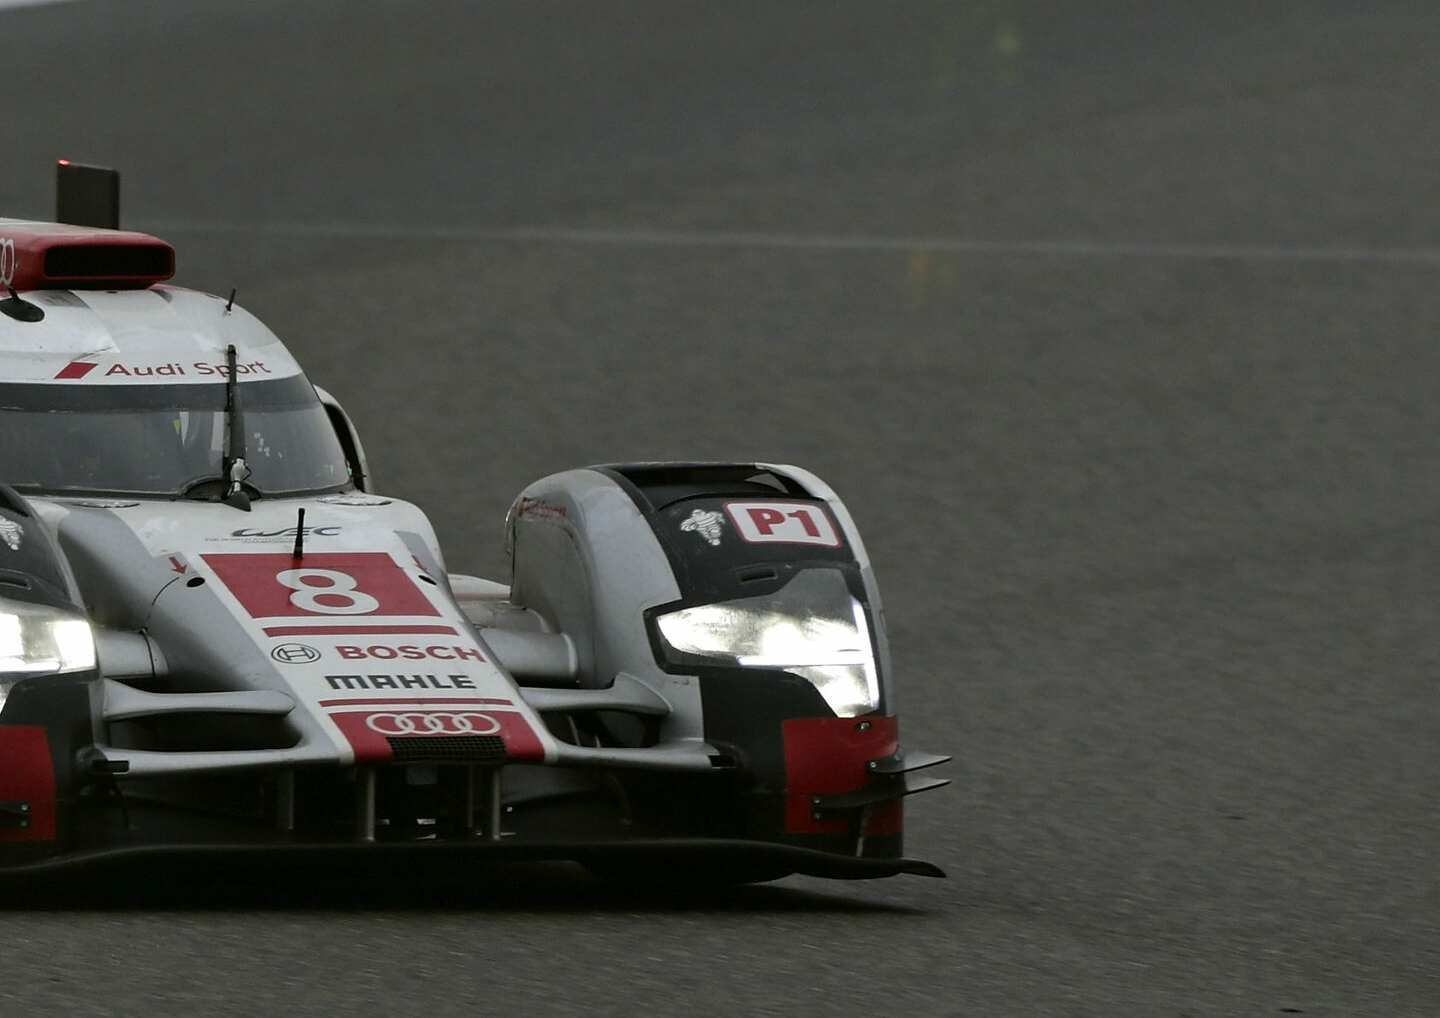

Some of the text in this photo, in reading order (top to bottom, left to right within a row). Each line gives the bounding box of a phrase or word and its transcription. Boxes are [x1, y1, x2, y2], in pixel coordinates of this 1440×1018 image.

[104, 360, 272, 379] Audi Sport
[745, 508, 821, 538] P1
[276, 568, 380, 615] 8
[334, 645, 487, 663] BOSCH
[324, 675, 477, 690] MAHLE
